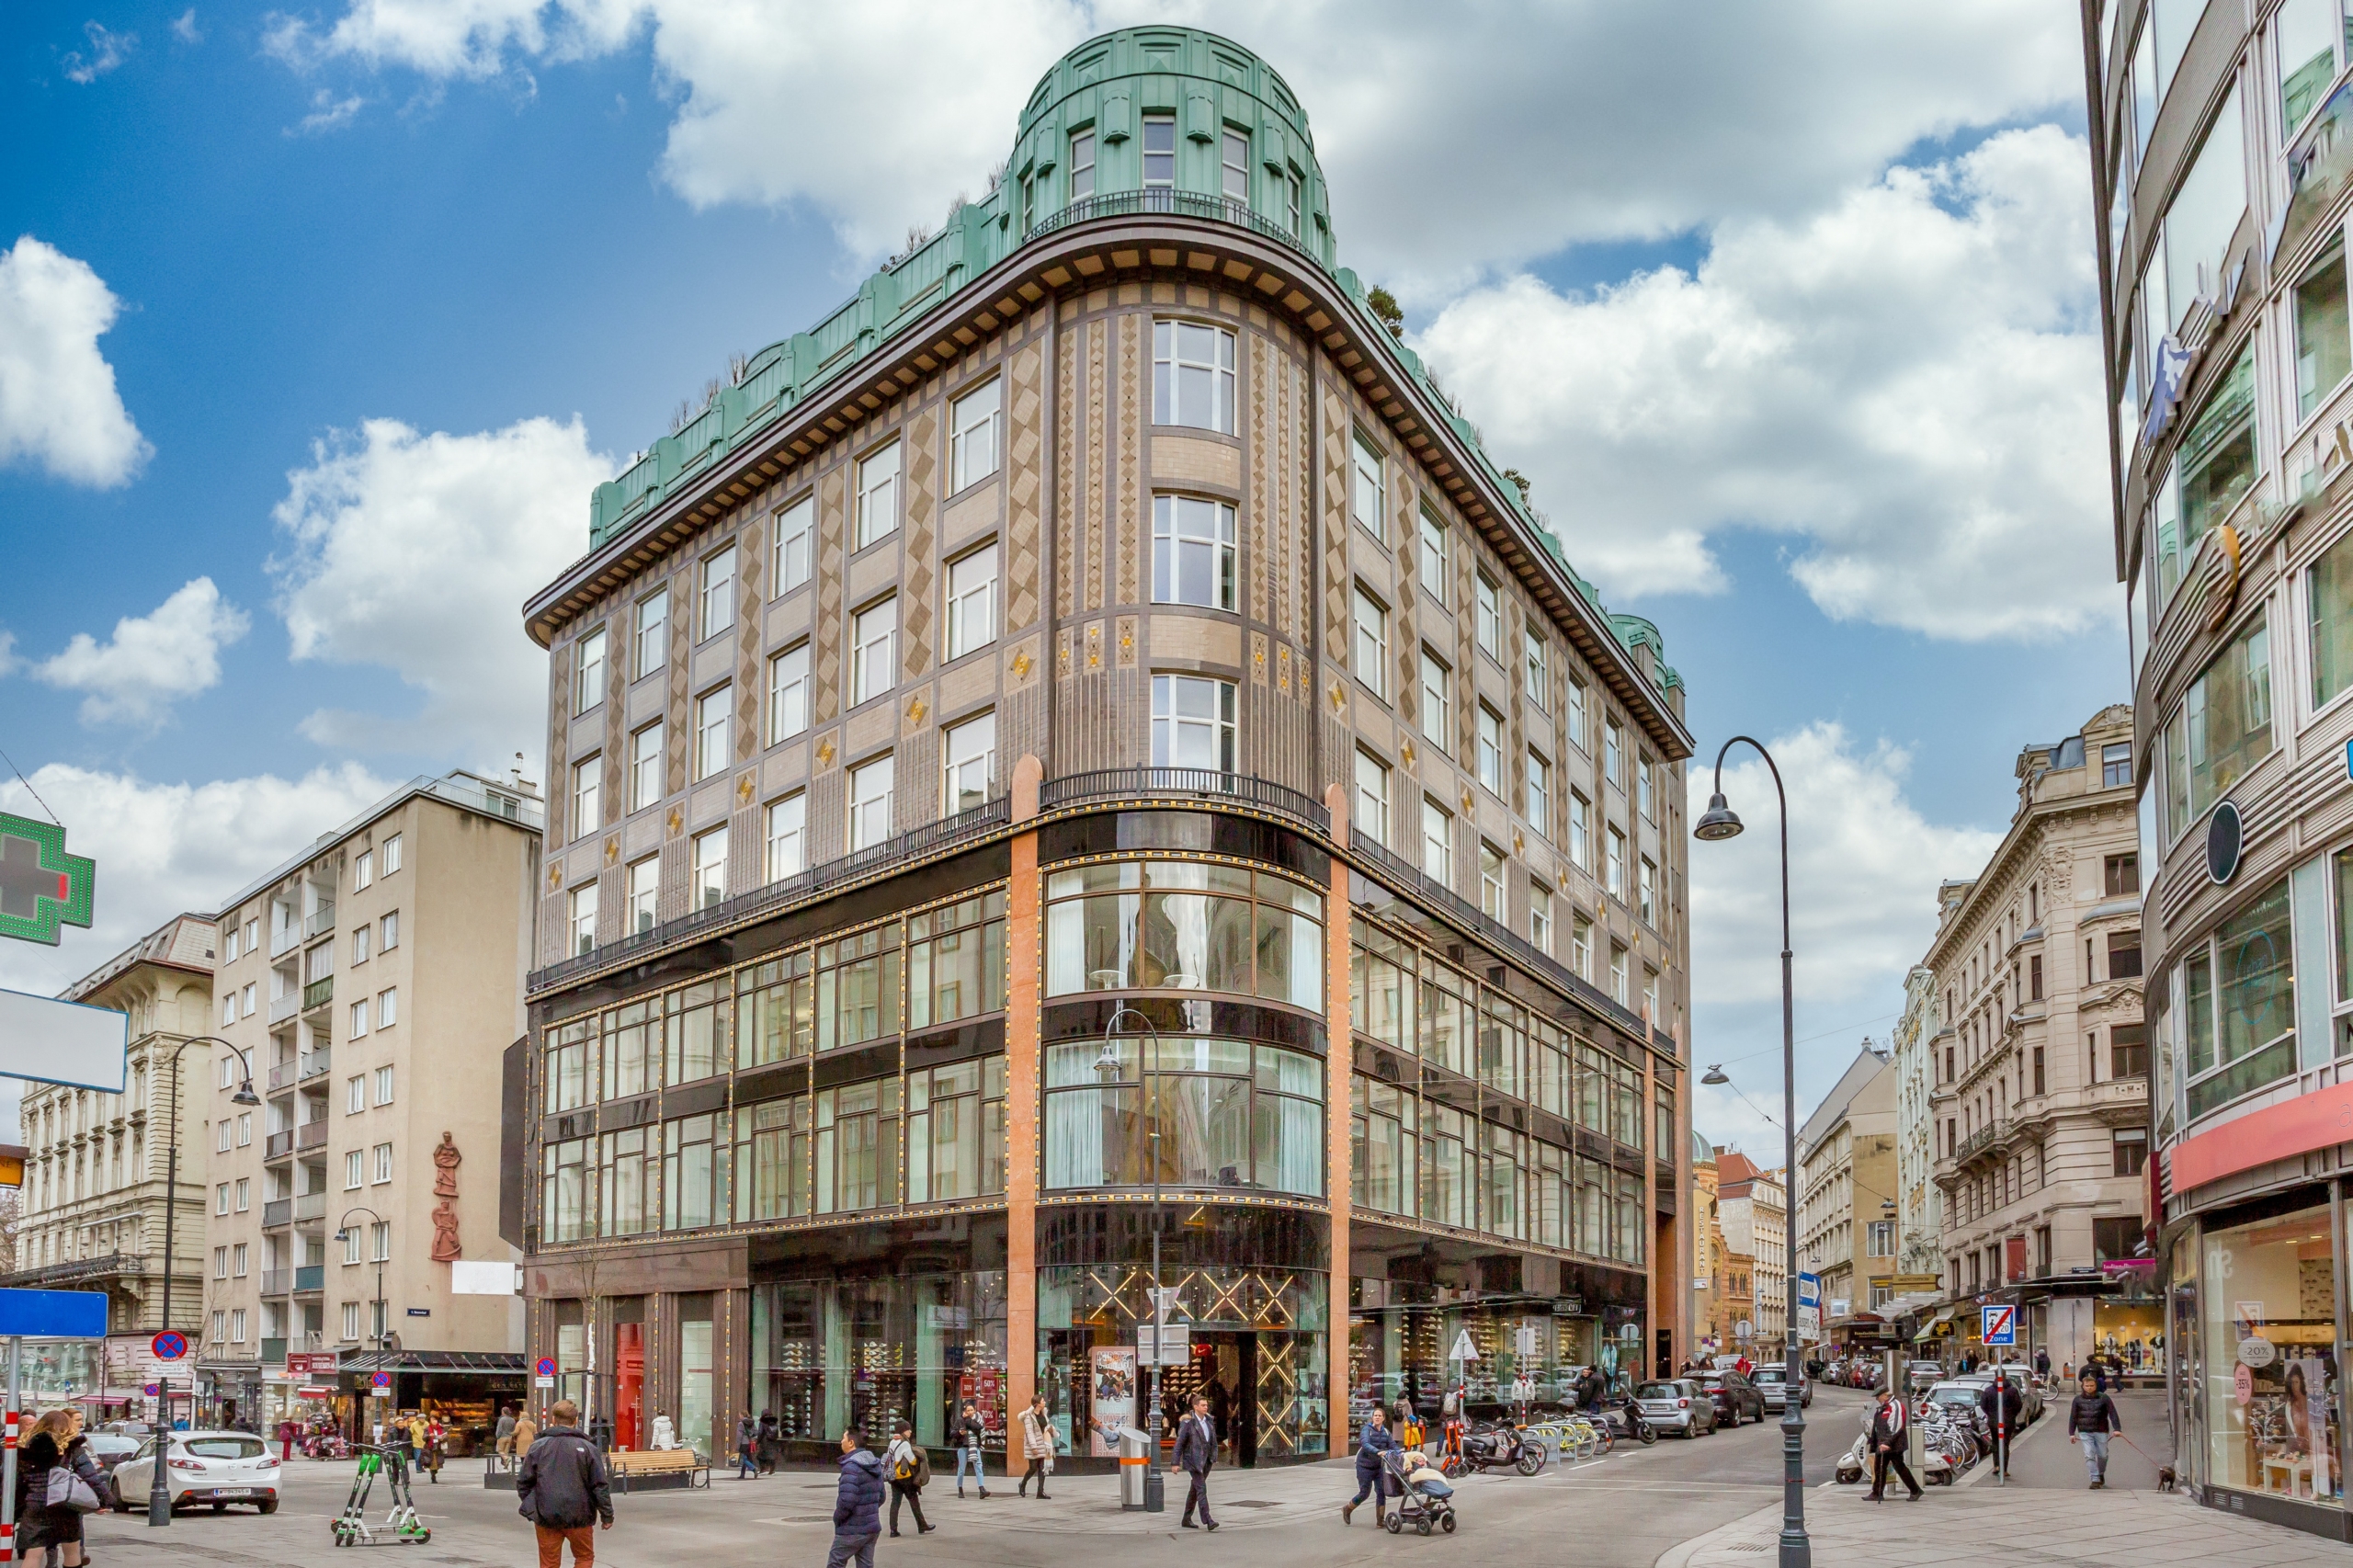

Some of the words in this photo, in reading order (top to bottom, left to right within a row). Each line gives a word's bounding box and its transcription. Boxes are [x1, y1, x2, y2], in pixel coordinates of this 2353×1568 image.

[2000, 1324, 2009, 1333] 20
[2244, 1346, 2269, 1356] -20%
[2236, 1379, 2250, 1389] -35%
[981, 1410, 994, 1419] 70%
